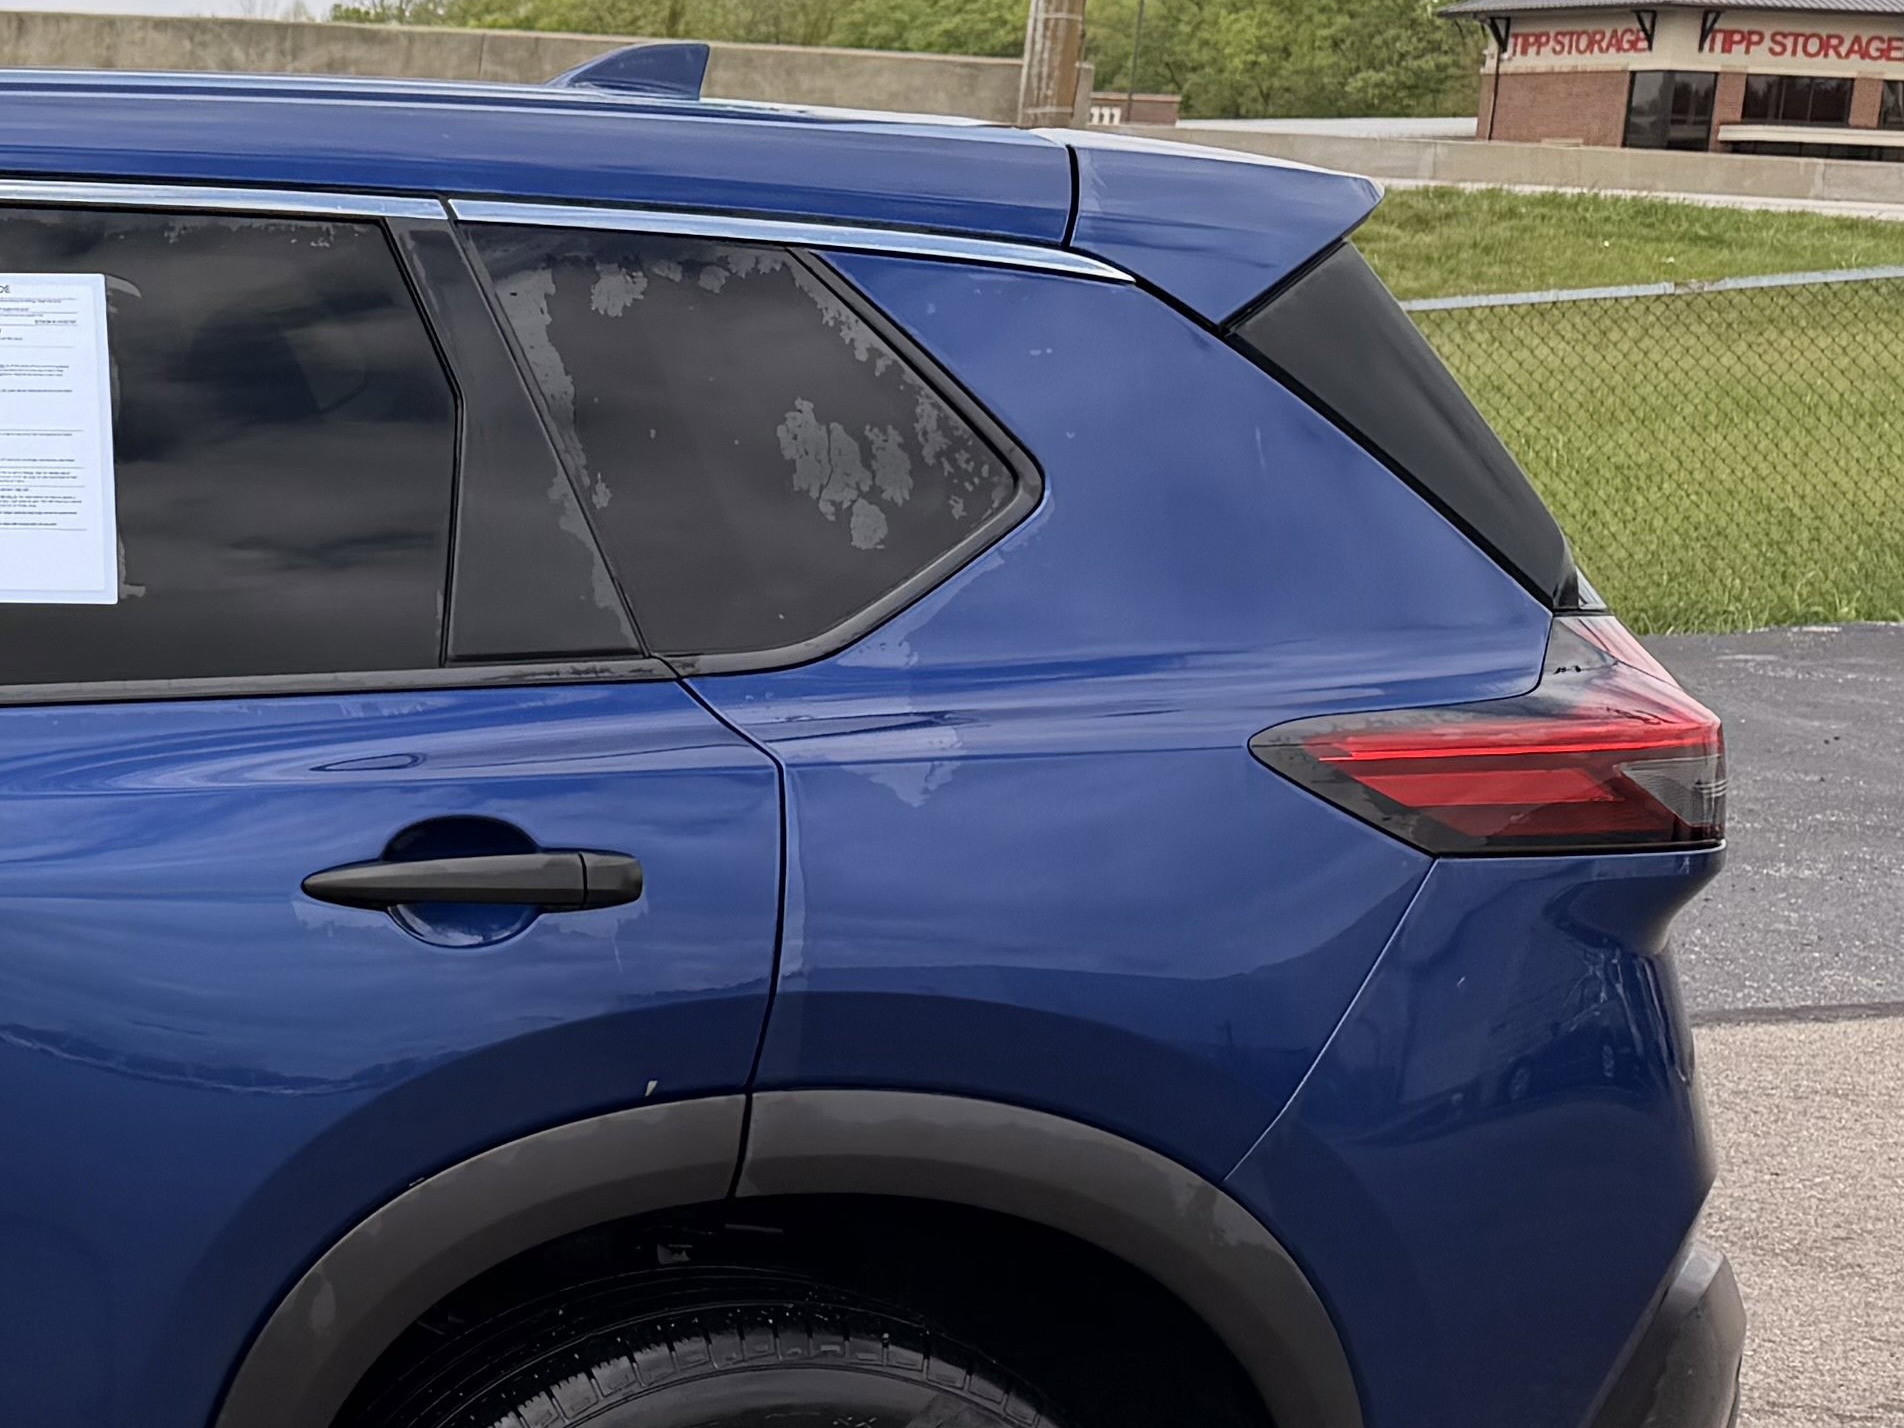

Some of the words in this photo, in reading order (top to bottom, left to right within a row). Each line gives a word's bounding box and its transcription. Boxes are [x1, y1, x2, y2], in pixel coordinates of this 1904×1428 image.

[1511, 32, 1550, 57] TIPP
[1552, 28, 1648, 55] STORAGE
[1709, 28, 1765, 54] TIPP
[1768, 31, 1904, 62] STORAGE
